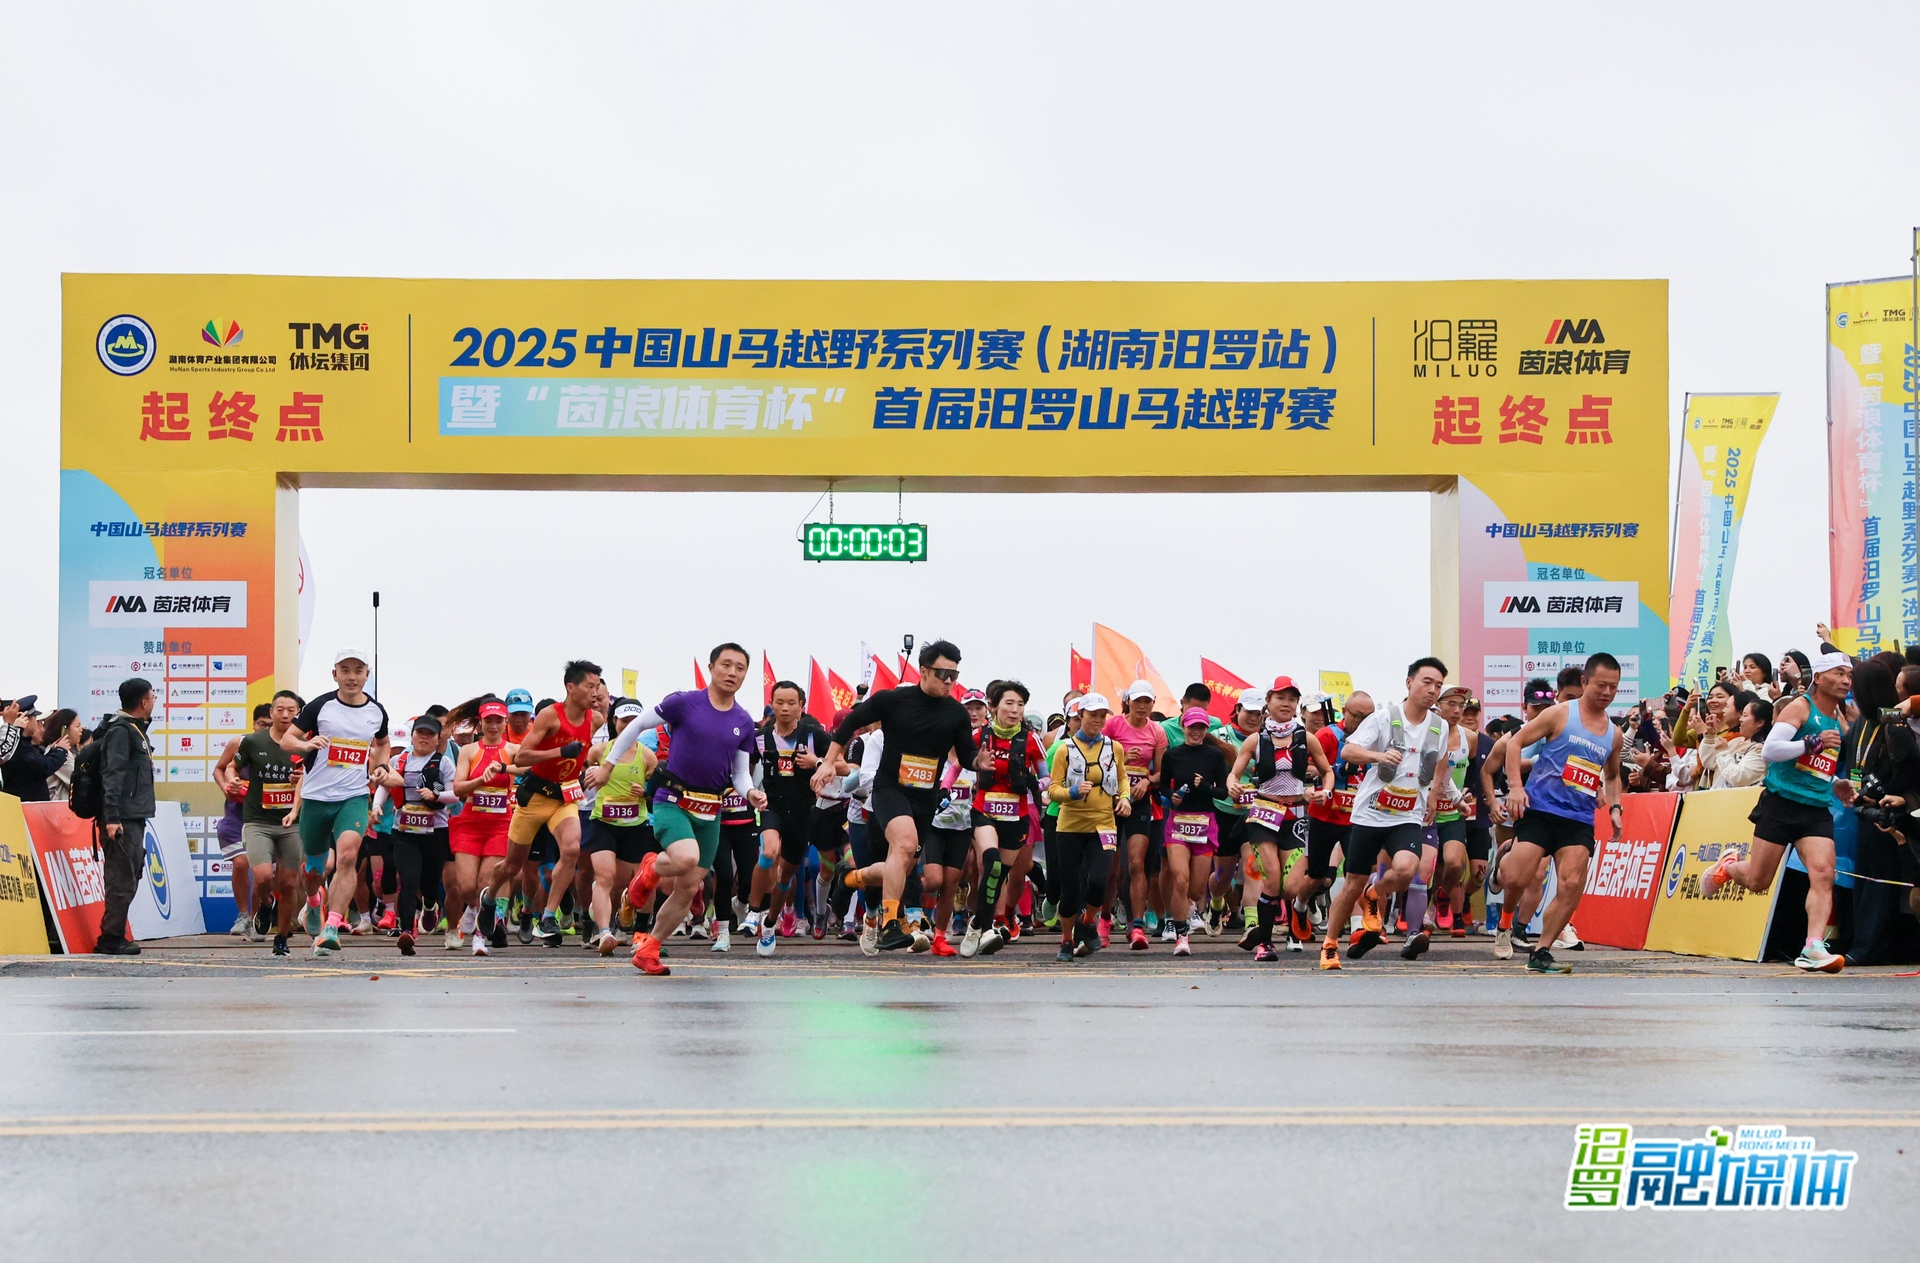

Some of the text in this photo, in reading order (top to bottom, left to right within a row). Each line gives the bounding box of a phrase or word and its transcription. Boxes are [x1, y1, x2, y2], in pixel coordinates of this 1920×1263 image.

[289, 323, 369, 350] TMG
[168, 355, 277, 365] 湖南体育产业集团有限公司
[289, 352, 369, 371] 体坛集团
[1518, 350, 1631, 376] 茵浪体育
[211, 366, 236, 374] Industry
[236, 366, 255, 374] Group
[1413, 365, 1497, 378] MILUO
[139, 390, 324, 442] 起终点
[1431, 394, 1613, 445] 起终点
[90, 521, 248, 538] 中国山马越野系列赛
[1485, 522, 1640, 538] 中国山马越野系列赛
[808, 527, 923, 557] 00:00:03
[143, 566, 193, 580] 冠名单位
[1537, 567, 1586, 580] 冠名单位
[153, 596, 231, 613] 茵浪体育
[1547, 596, 1623, 613] 茵浪体育
[143, 641, 193, 654] 赞助单位
[1537, 641, 1586, 654] 赞助单位
[337, 750, 361, 762] 1142
[1808, 753, 1831, 772] 1003
[907, 767, 933, 781] 7483
[1572, 769, 1595, 787] 1194
[269, 793, 292, 803] 1180
[479, 796, 502, 806] 3137
[723, 796, 743, 806] 3167
[1386, 796, 1410, 809] 1004
[609, 805, 633, 816] 3136
[688, 801, 713, 812] 1144
[989, 803, 1014, 814] 3032
[1437, 801, 1454, 810] 364
[405, 815, 428, 825] 3016
[1252, 809, 1277, 822] 3154
[1179, 825, 1202, 835] 3037
[1593, 840, 1662, 900] 茵浪体育
